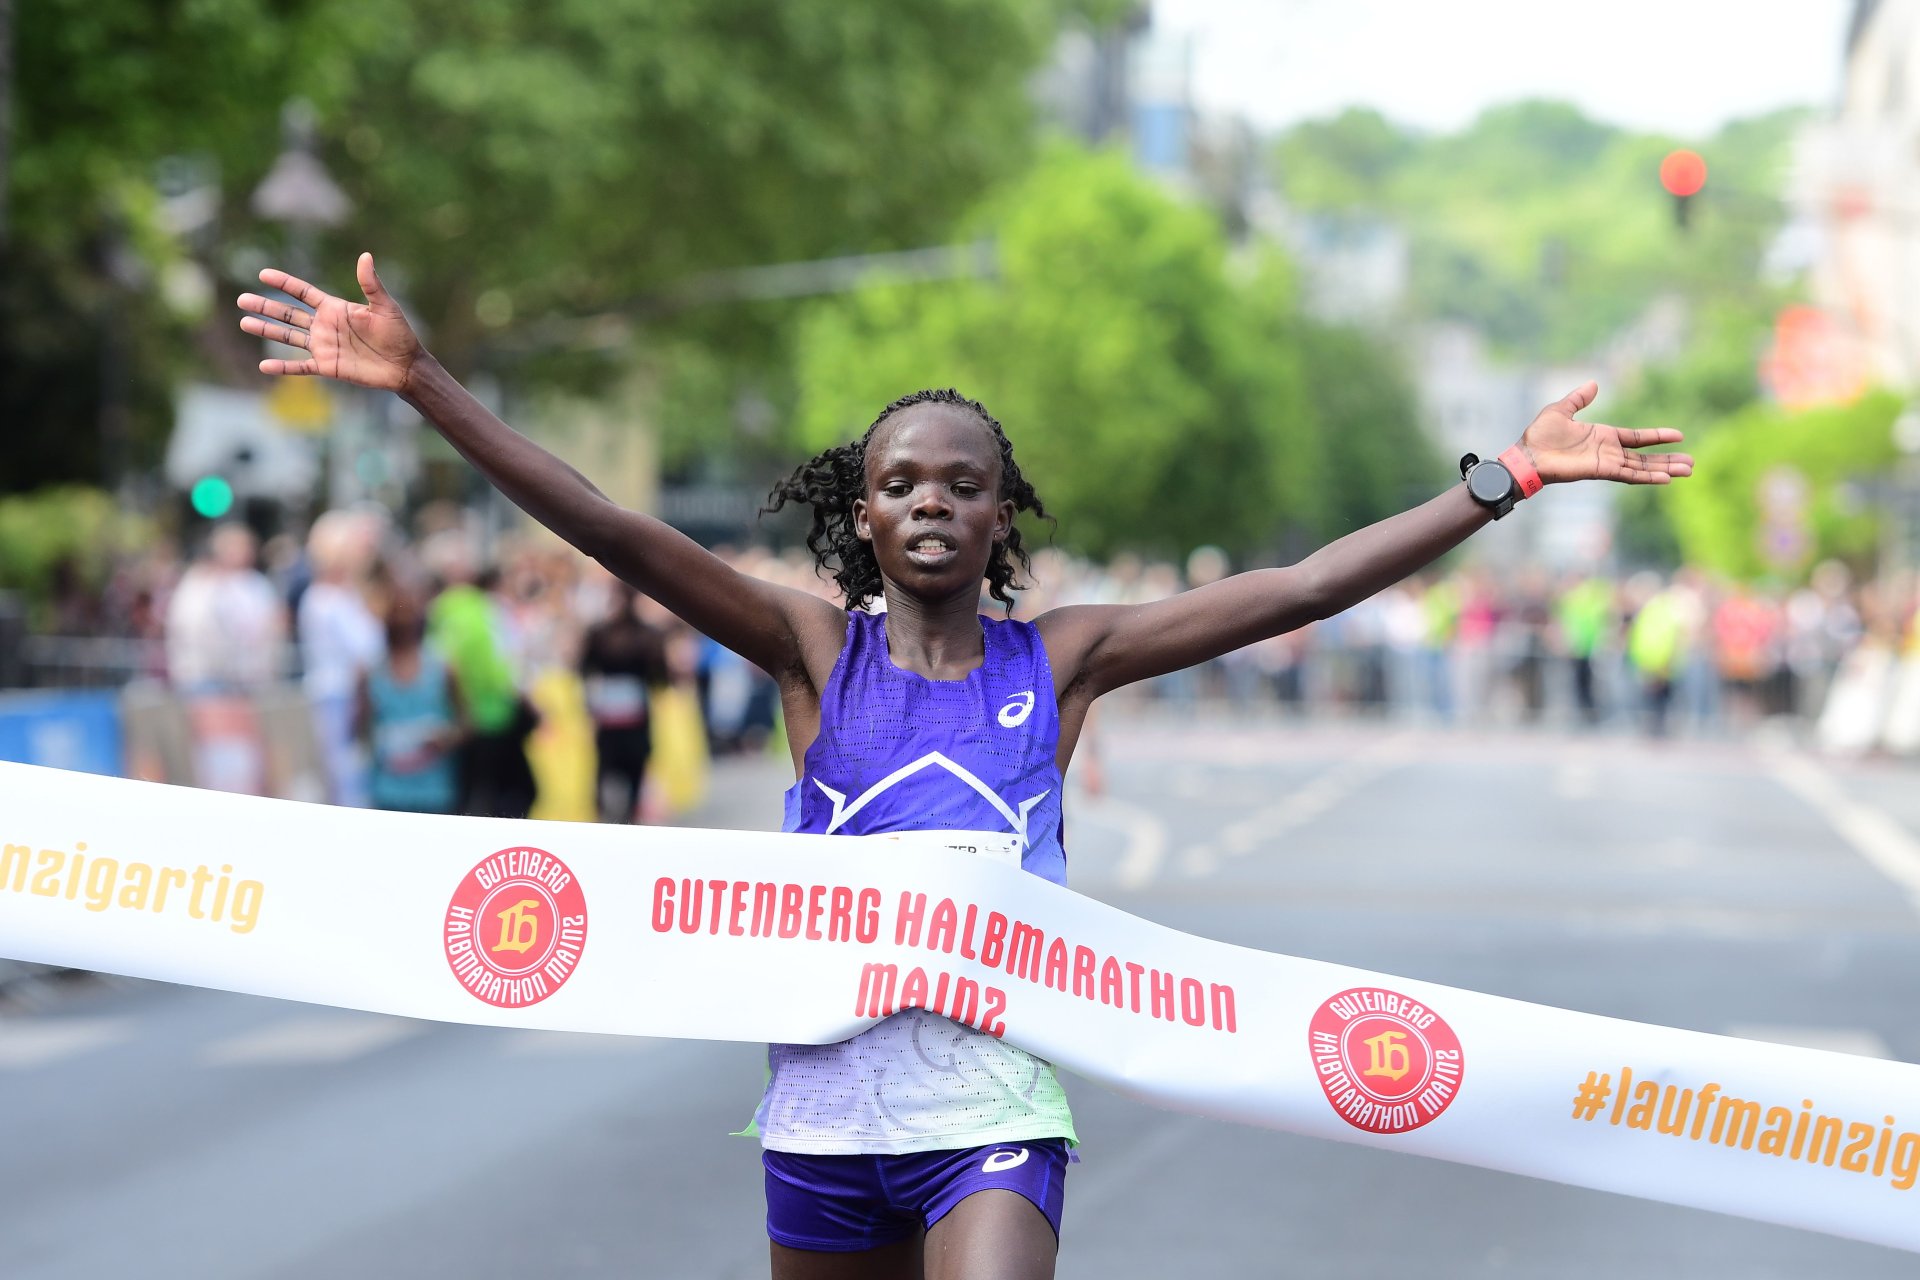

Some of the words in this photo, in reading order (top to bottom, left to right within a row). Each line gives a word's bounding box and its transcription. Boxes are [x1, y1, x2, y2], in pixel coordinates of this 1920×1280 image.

[0, 842, 264, 934] nzigartig
[475, 851, 571, 894] GUTENBERG
[448, 905, 548, 1004] HALBMARATHON
[544, 914, 584, 983] MAINZ
[652, 878, 881, 944] GUTENBERG
[896, 893, 1237, 1033] HALBMARATHON
[855, 963, 1006, 1038] MAINZ
[1329, 991, 1436, 1030] GUTENBERG
[1313, 1031, 1419, 1130] HALBMARATHON
[1417, 1049, 1460, 1116] MAINZ
[1572, 1066, 1920, 1190] #laufmainzig
